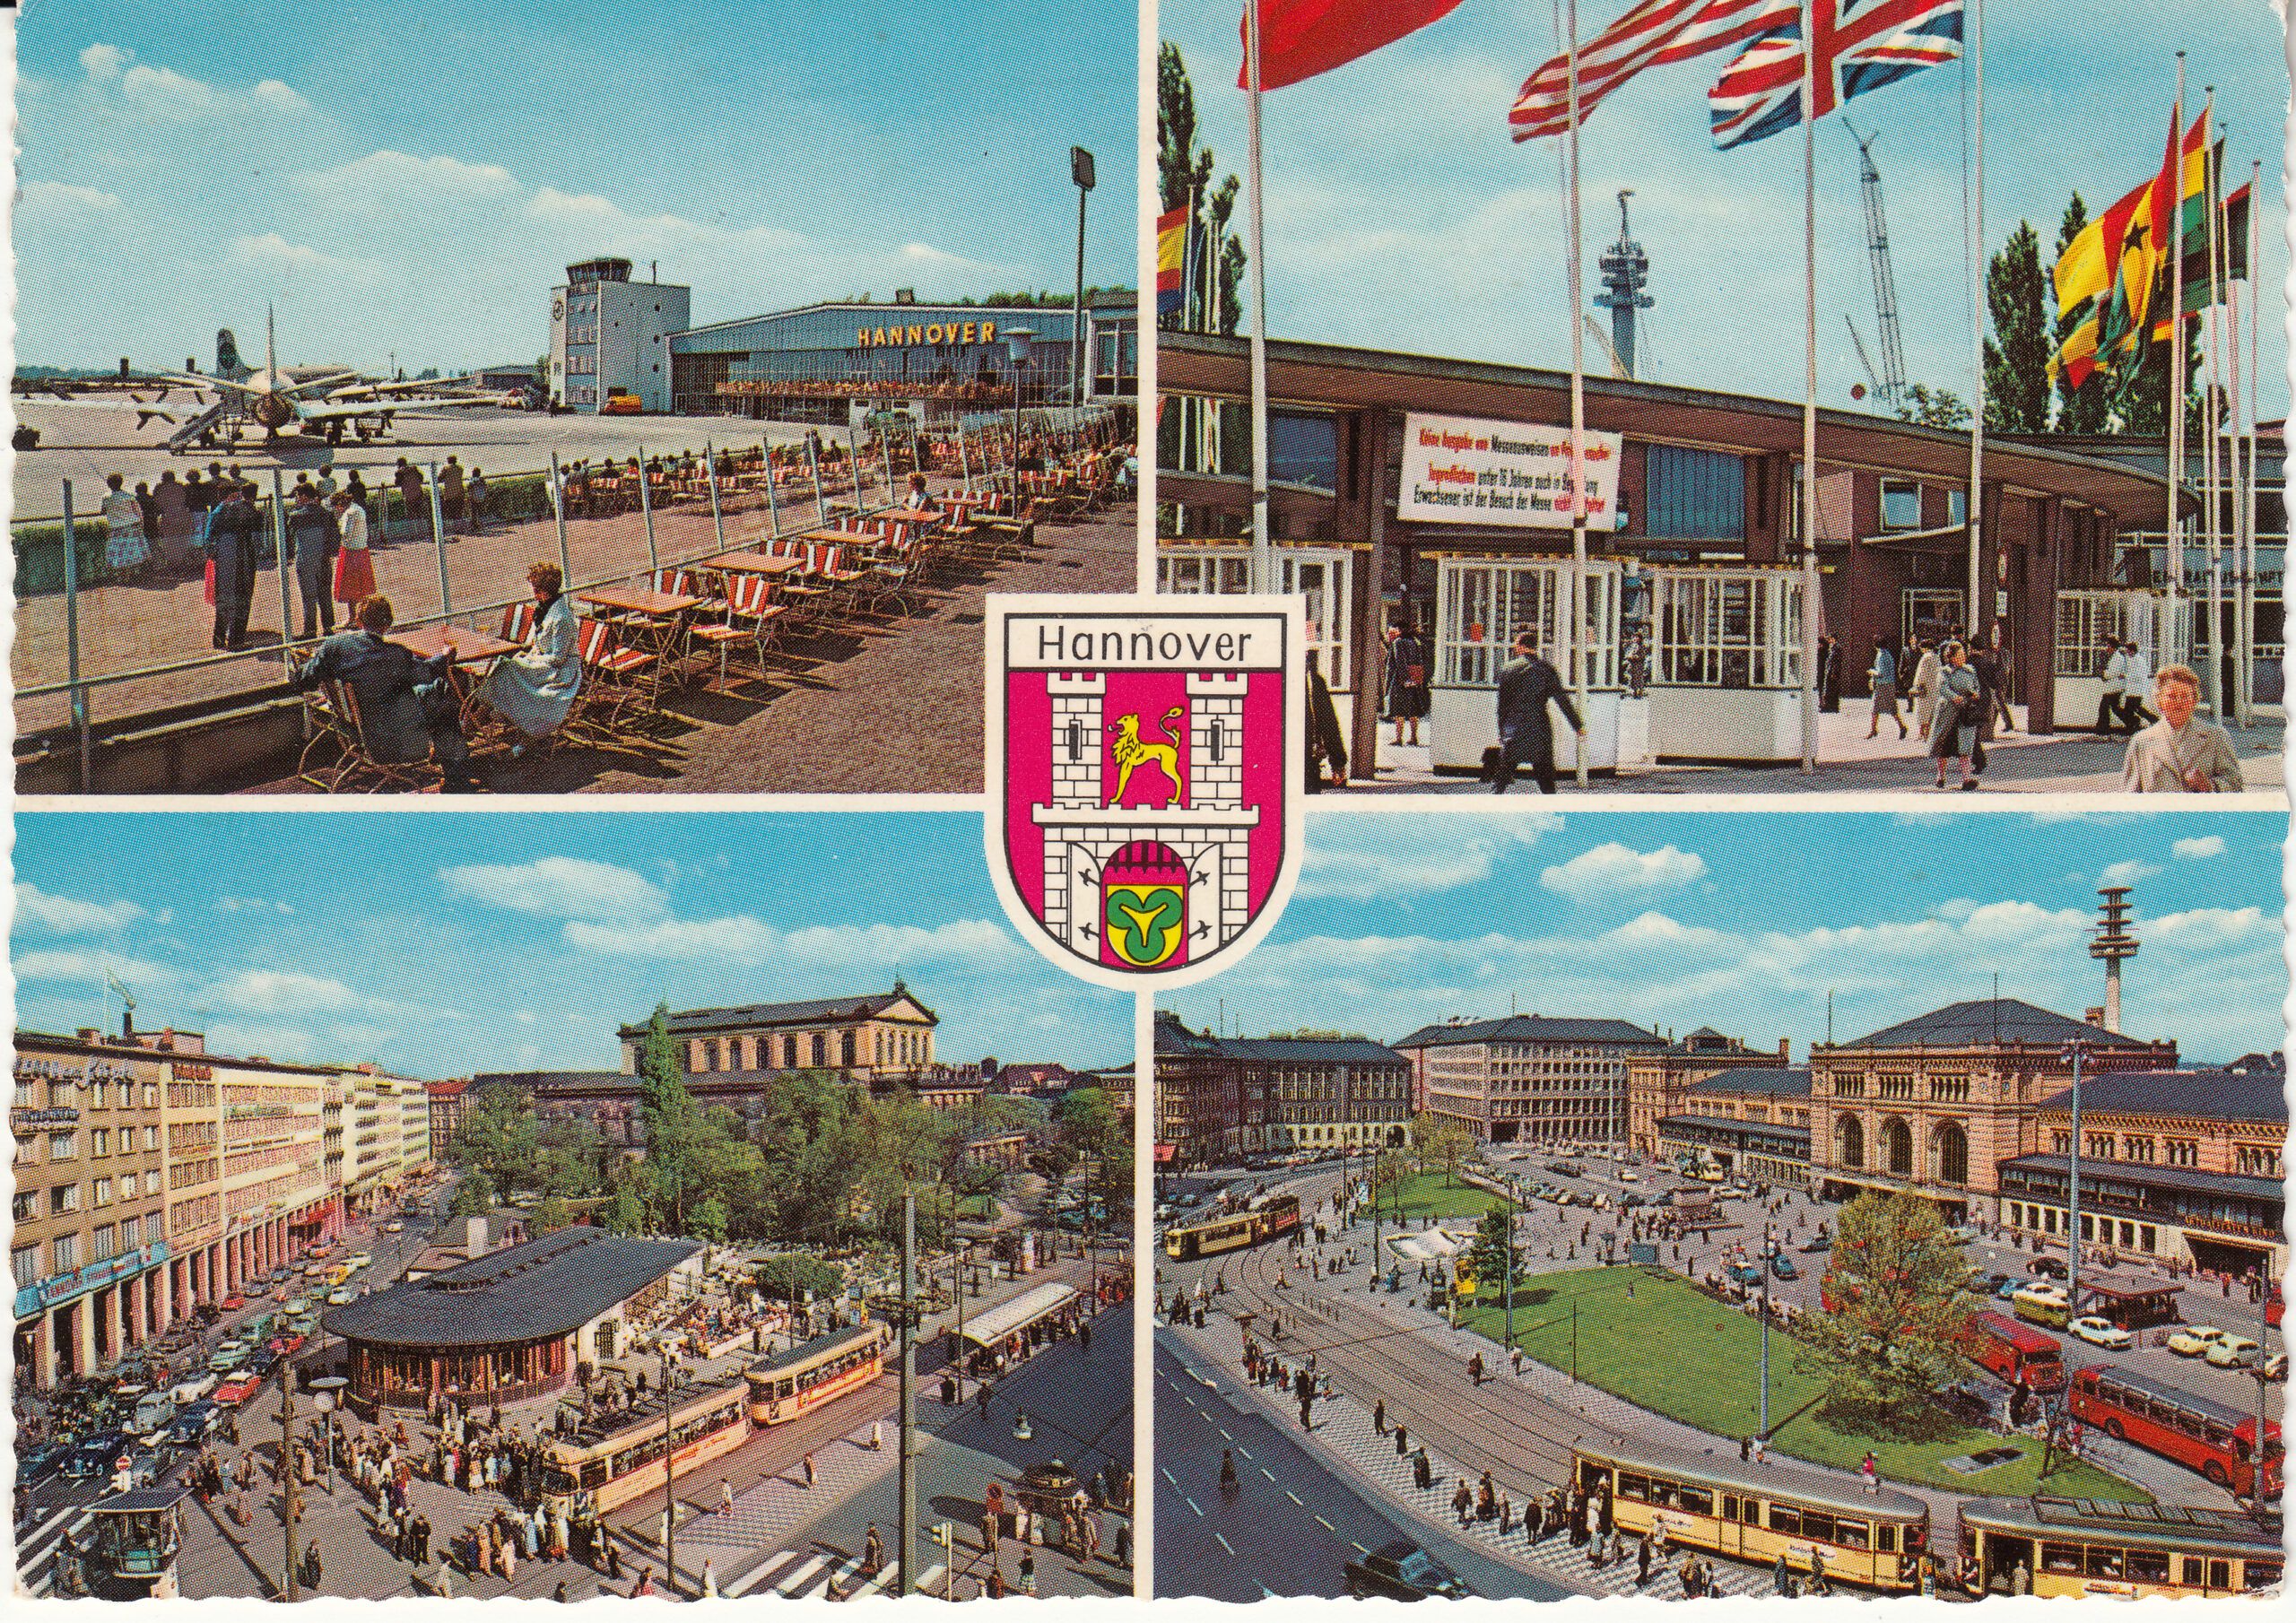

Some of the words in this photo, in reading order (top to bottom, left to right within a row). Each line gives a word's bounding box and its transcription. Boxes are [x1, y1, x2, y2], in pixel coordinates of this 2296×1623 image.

[857, 321, 997, 347] HANNOVER
[1429, 460, 1476, 485] Jugendlichen
[1489, 489, 1514, 509] Besuch
